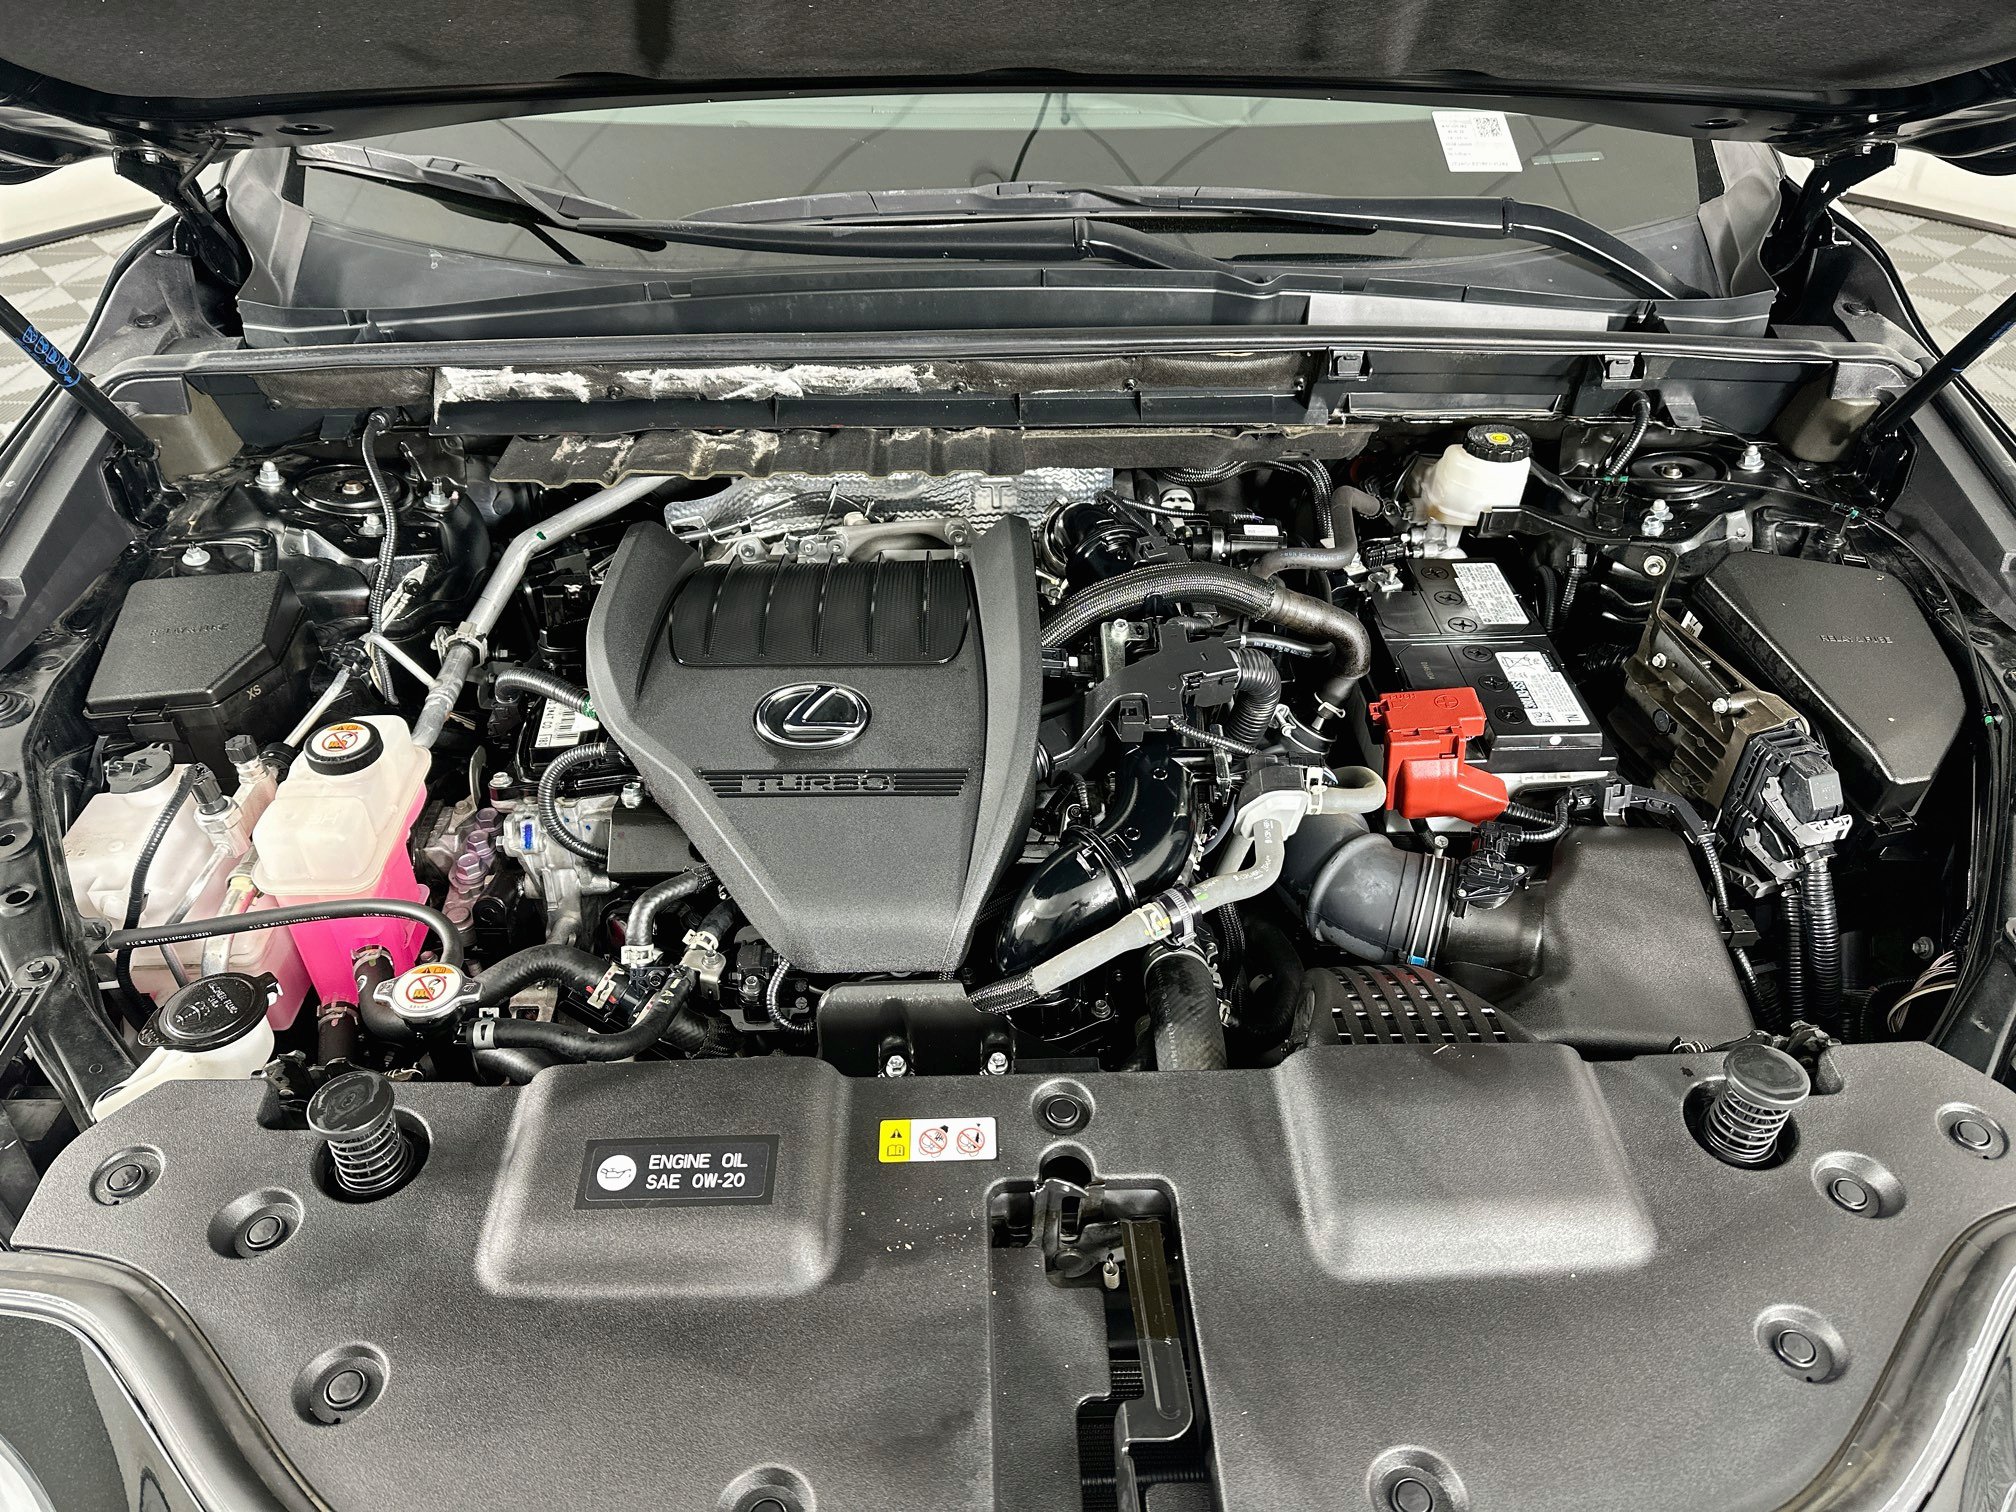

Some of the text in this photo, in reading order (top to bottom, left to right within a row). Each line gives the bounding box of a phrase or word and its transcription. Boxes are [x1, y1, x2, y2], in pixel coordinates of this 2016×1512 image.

[246, 684, 262, 701] XS
[746, 773, 891, 792] TURBO
[648, 1152, 748, 1170] ENGINE OIL
[645, 1172, 746, 1190] SAE 0W-20
